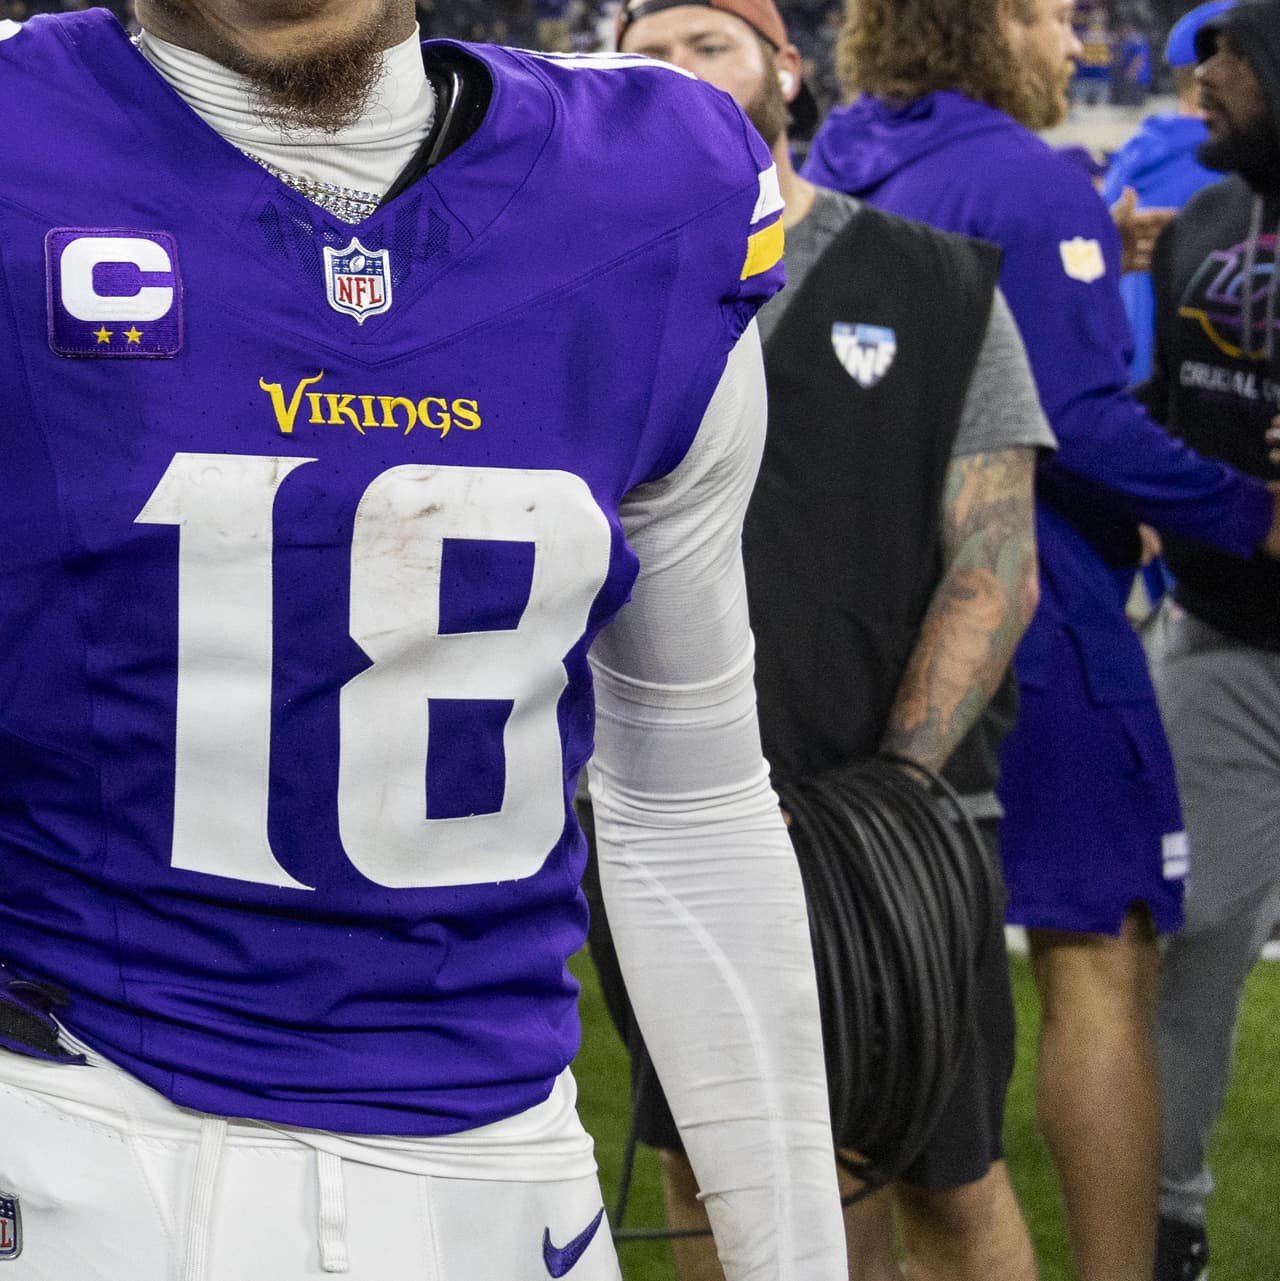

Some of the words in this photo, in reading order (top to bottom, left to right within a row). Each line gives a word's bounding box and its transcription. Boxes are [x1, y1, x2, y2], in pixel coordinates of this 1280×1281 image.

[61, 237, 174, 322] C
[337, 276, 382, 308] NFL
[258, 368, 482, 439] VIKINGS
[134, 452, 611, 890] 18
